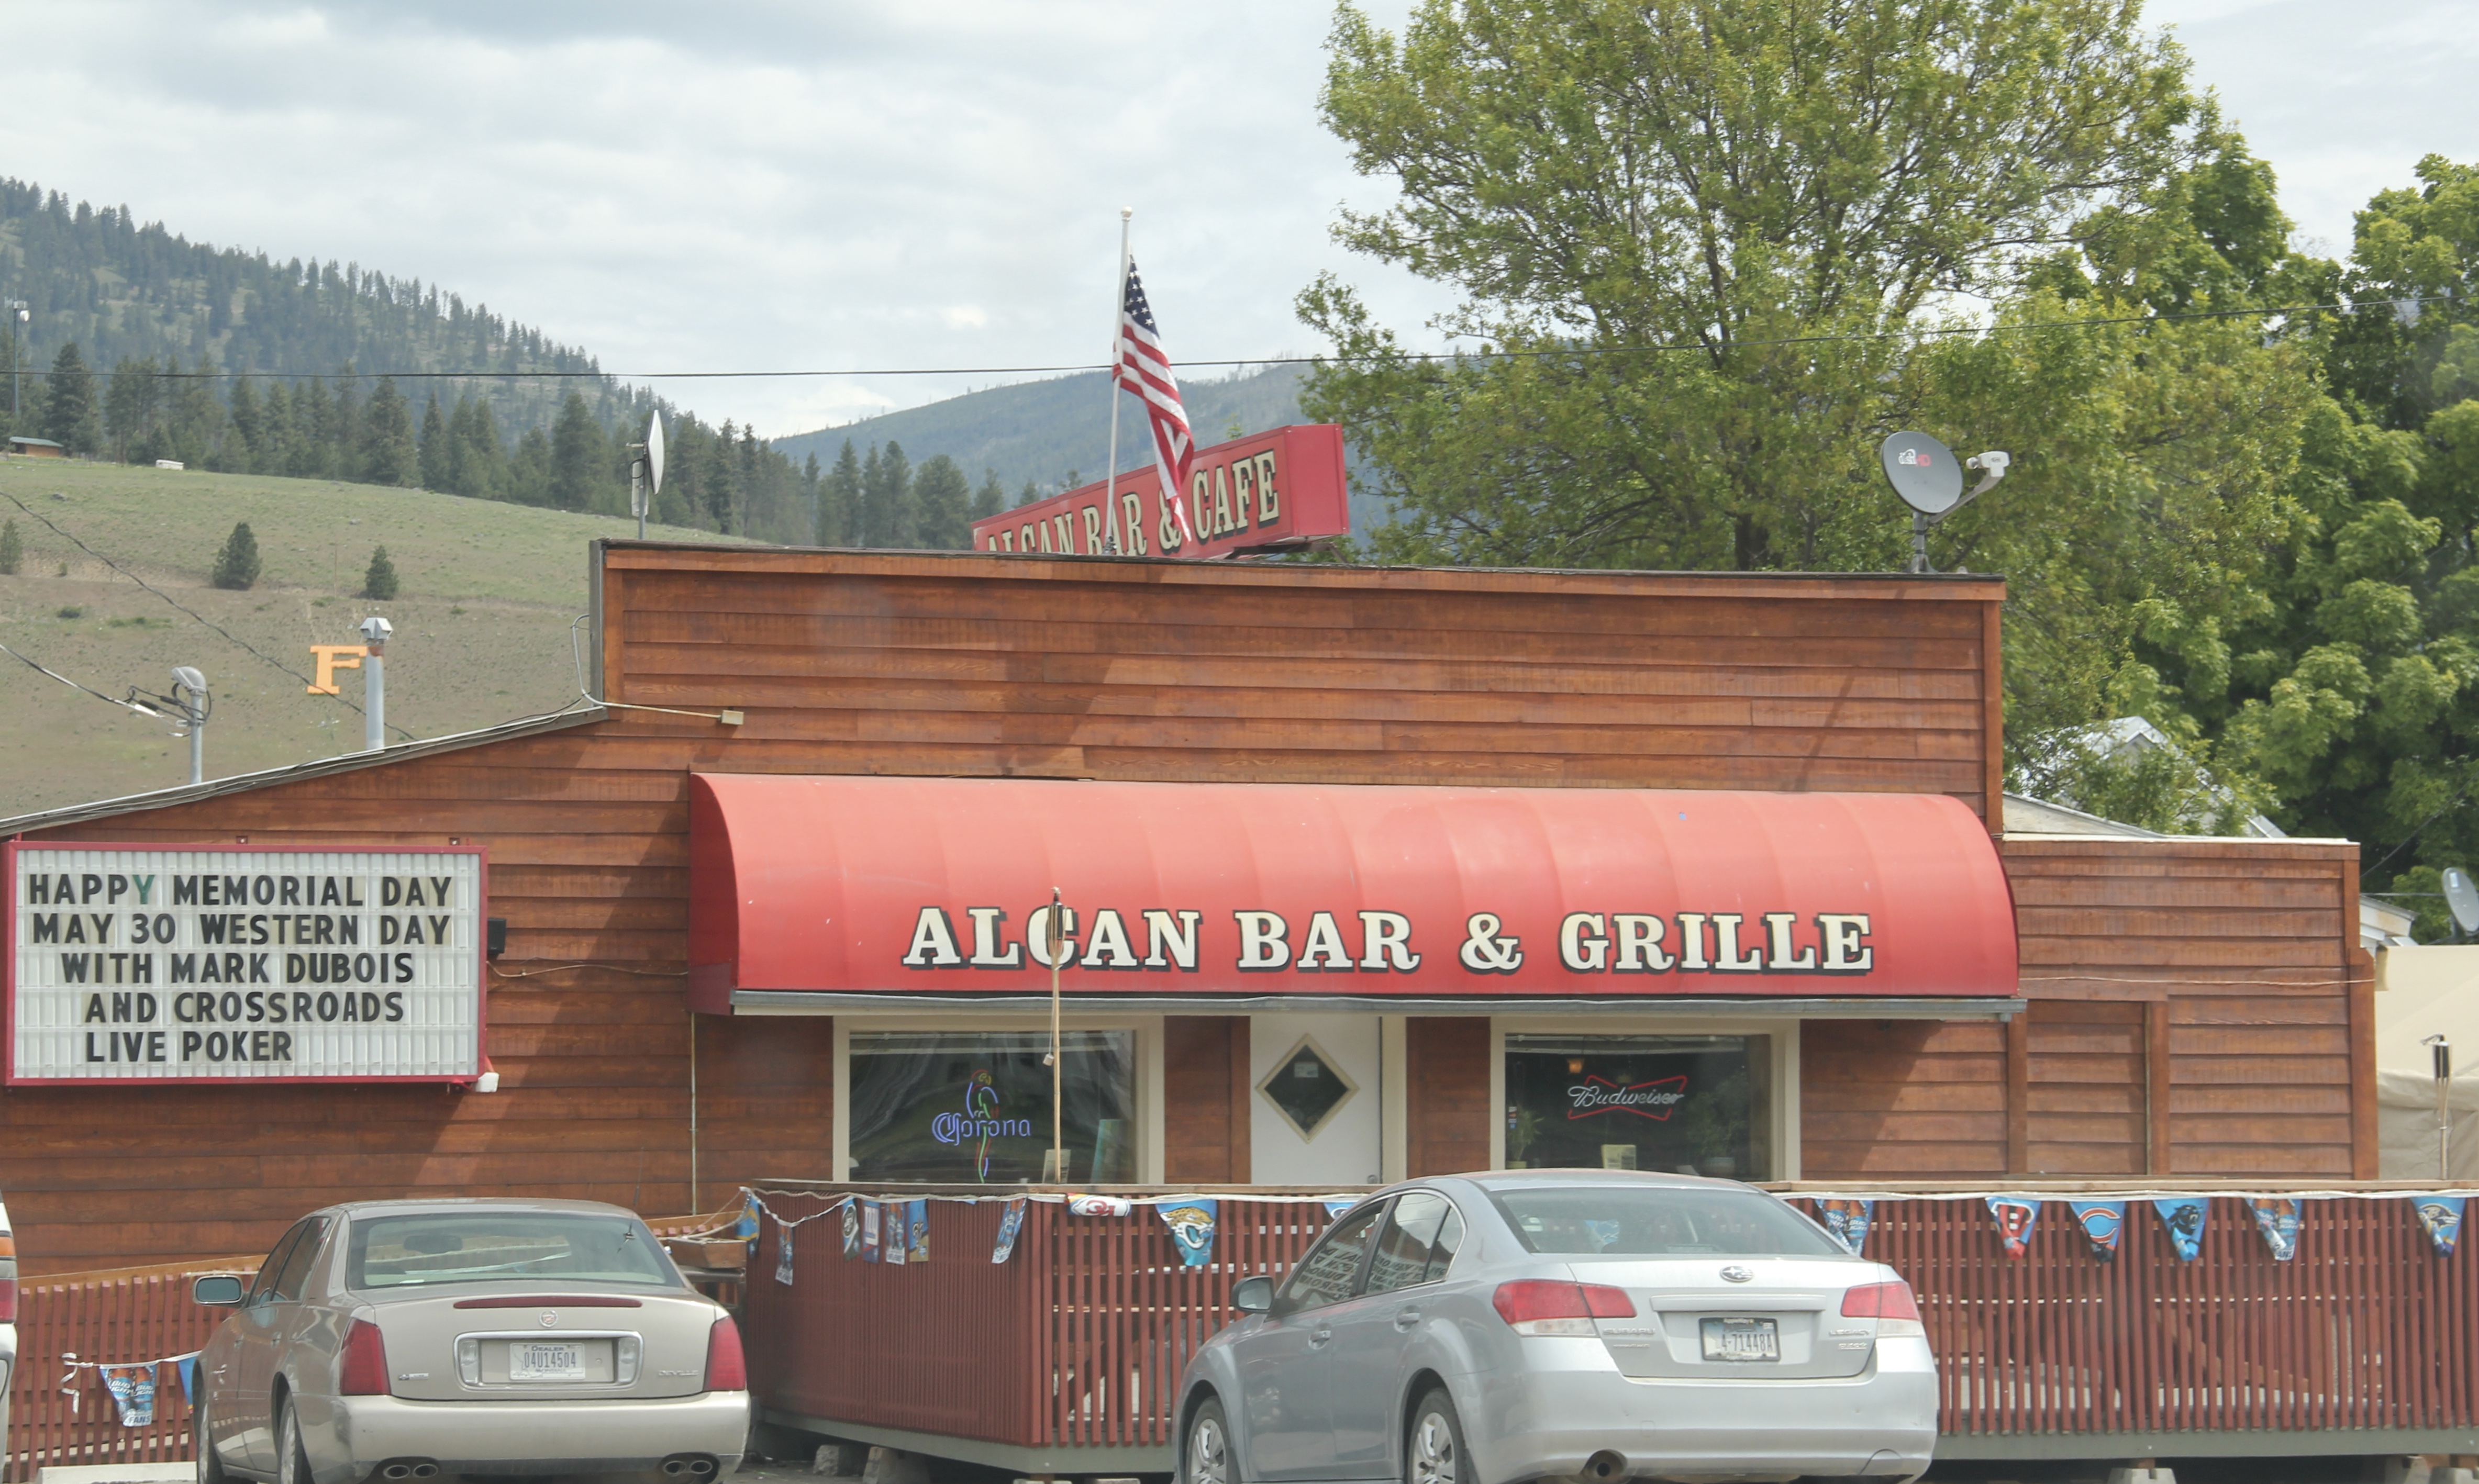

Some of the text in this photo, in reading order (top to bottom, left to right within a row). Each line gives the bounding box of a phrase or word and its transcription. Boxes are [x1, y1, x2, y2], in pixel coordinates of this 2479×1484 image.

[1192, 449, 1280, 545] CAFE
[307, 645, 368, 695] F
[30, 874, 452, 907] HAPPY MEMORIAL DAY
[34, 913, 451, 945] MAY 30 WESTERN DAY
[902, 906, 1873, 976] ALCAN BAR & GRILLE
[61, 953, 413, 984] WITH MARK DUBOIS
[85, 991, 404, 1023] AND CROSSROADS
[86, 1031, 292, 1063] LIVE POKER
[1568, 1086, 1685, 1107] Budweiser
[932, 1112, 1031, 1146] Corona
